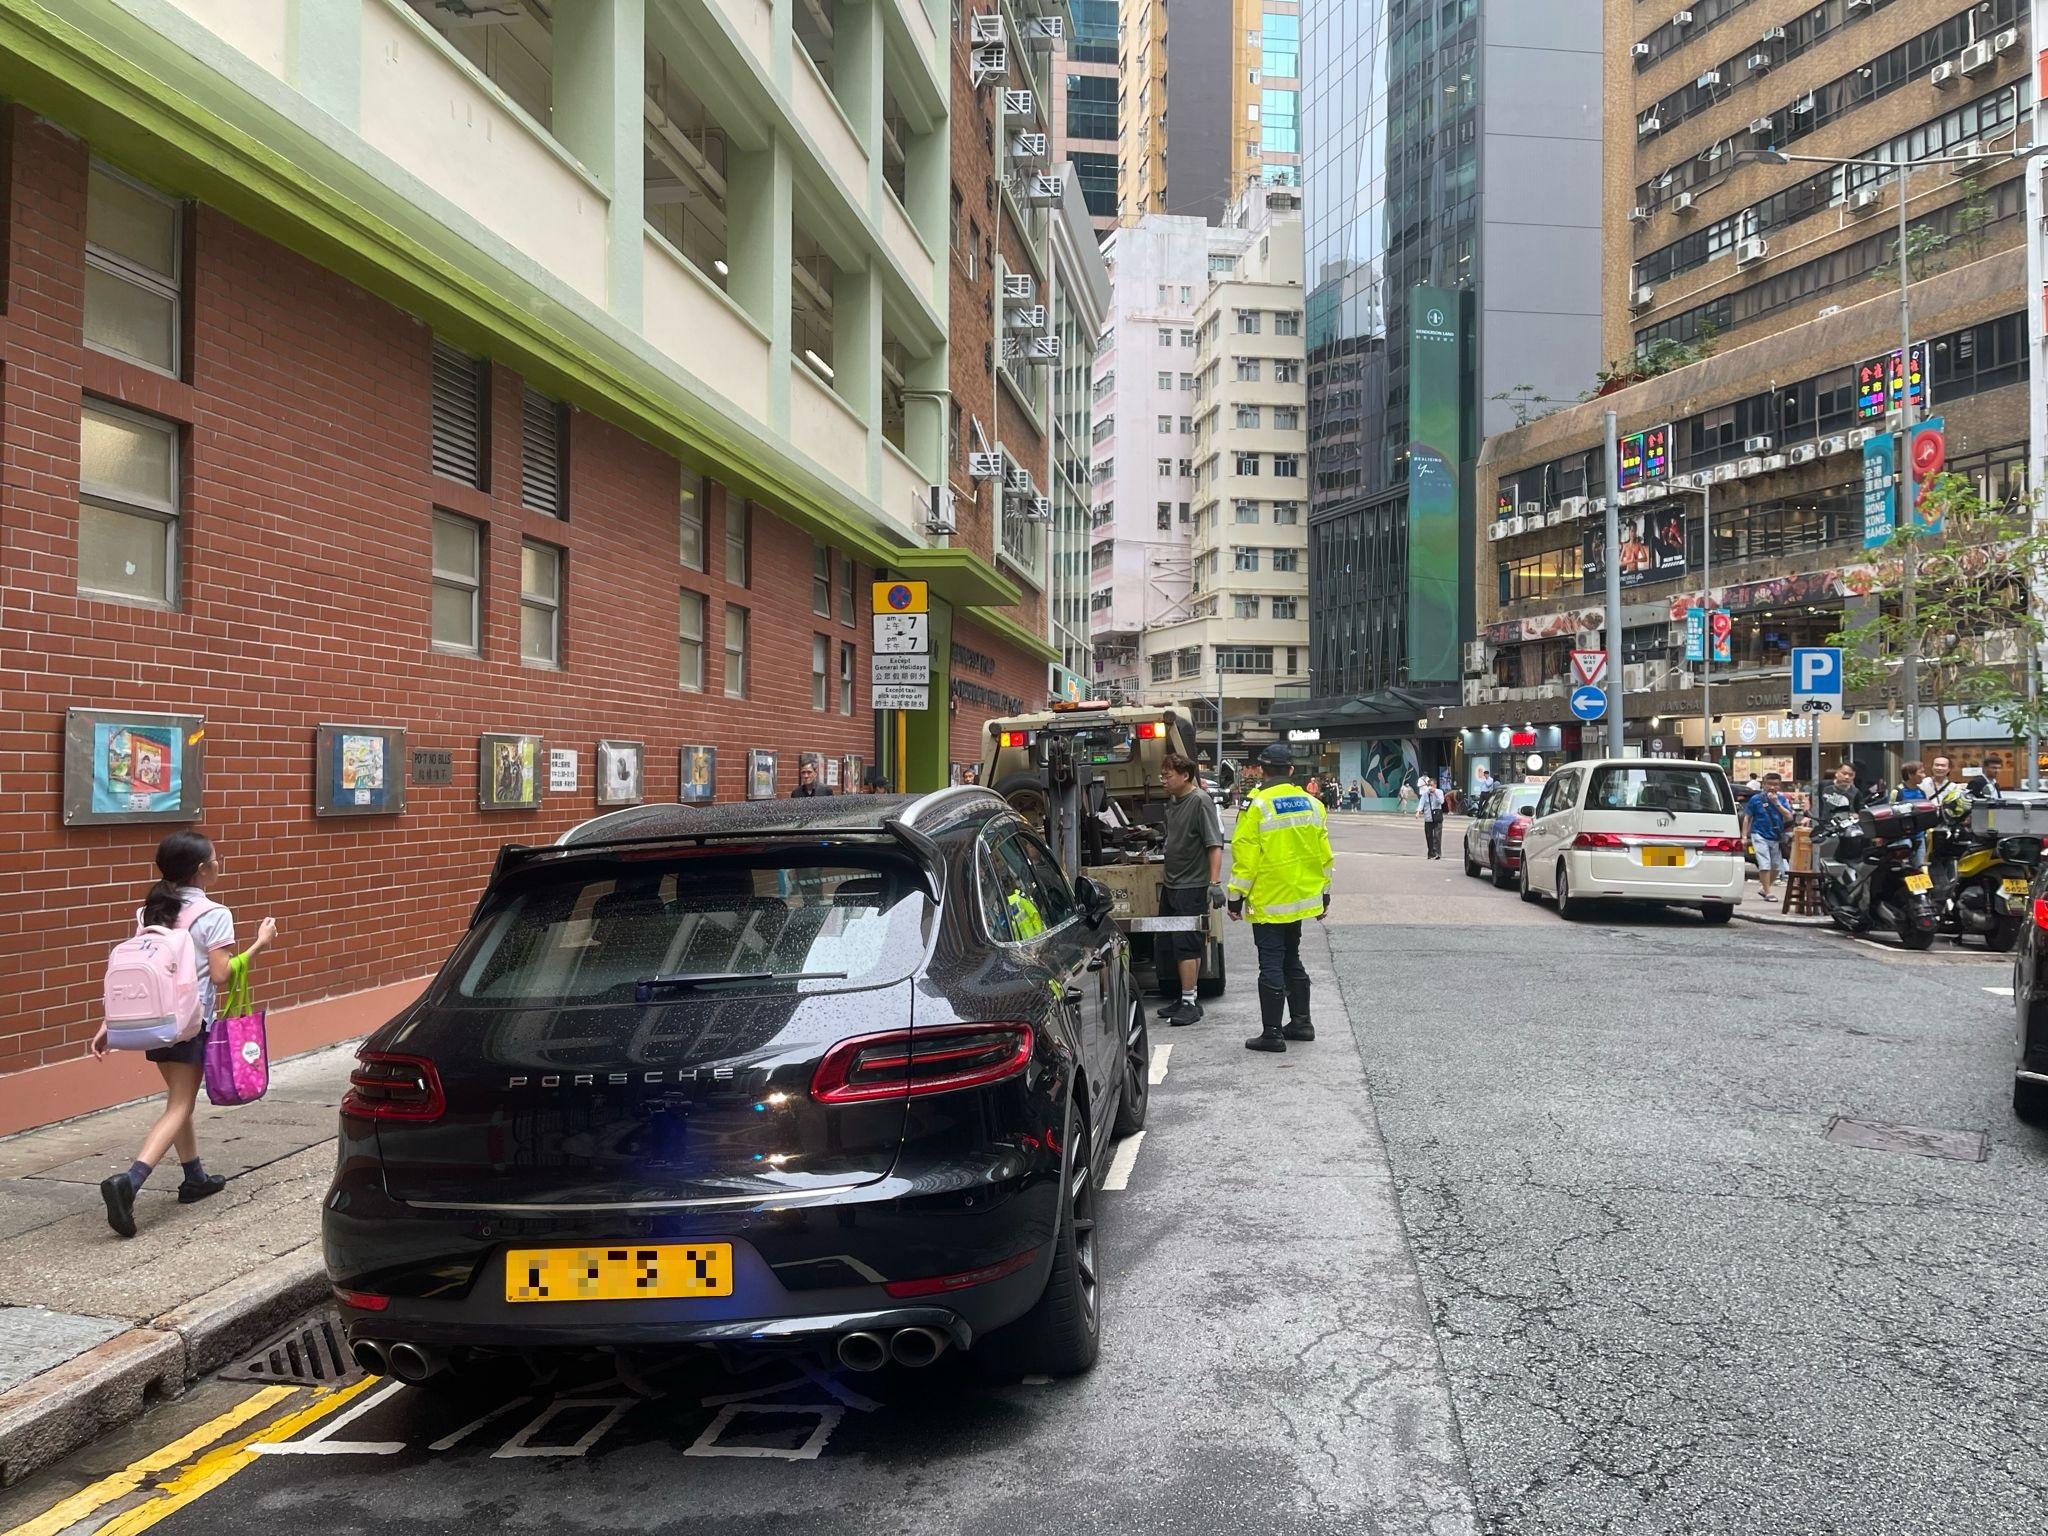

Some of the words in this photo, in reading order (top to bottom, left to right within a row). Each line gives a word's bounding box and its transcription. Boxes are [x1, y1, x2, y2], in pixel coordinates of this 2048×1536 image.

[1865, 494, 1876, 504] THE
[1865, 501, 1886, 515] HONG
[1865, 513, 1886, 527] KONG
[1865, 524, 1892, 539] GAMES
[884, 622, 899, 630] 上午
[908, 616, 917, 629] 7
[885, 643, 900, 651] 下午
[908, 637, 918, 650] 7
[438, 753, 450, 765] BILLS
[1282, 800, 1304, 808] POLICE
[112, 984, 149, 1000] FILA
[509, 1067, 734, 1088] PORSCHE
